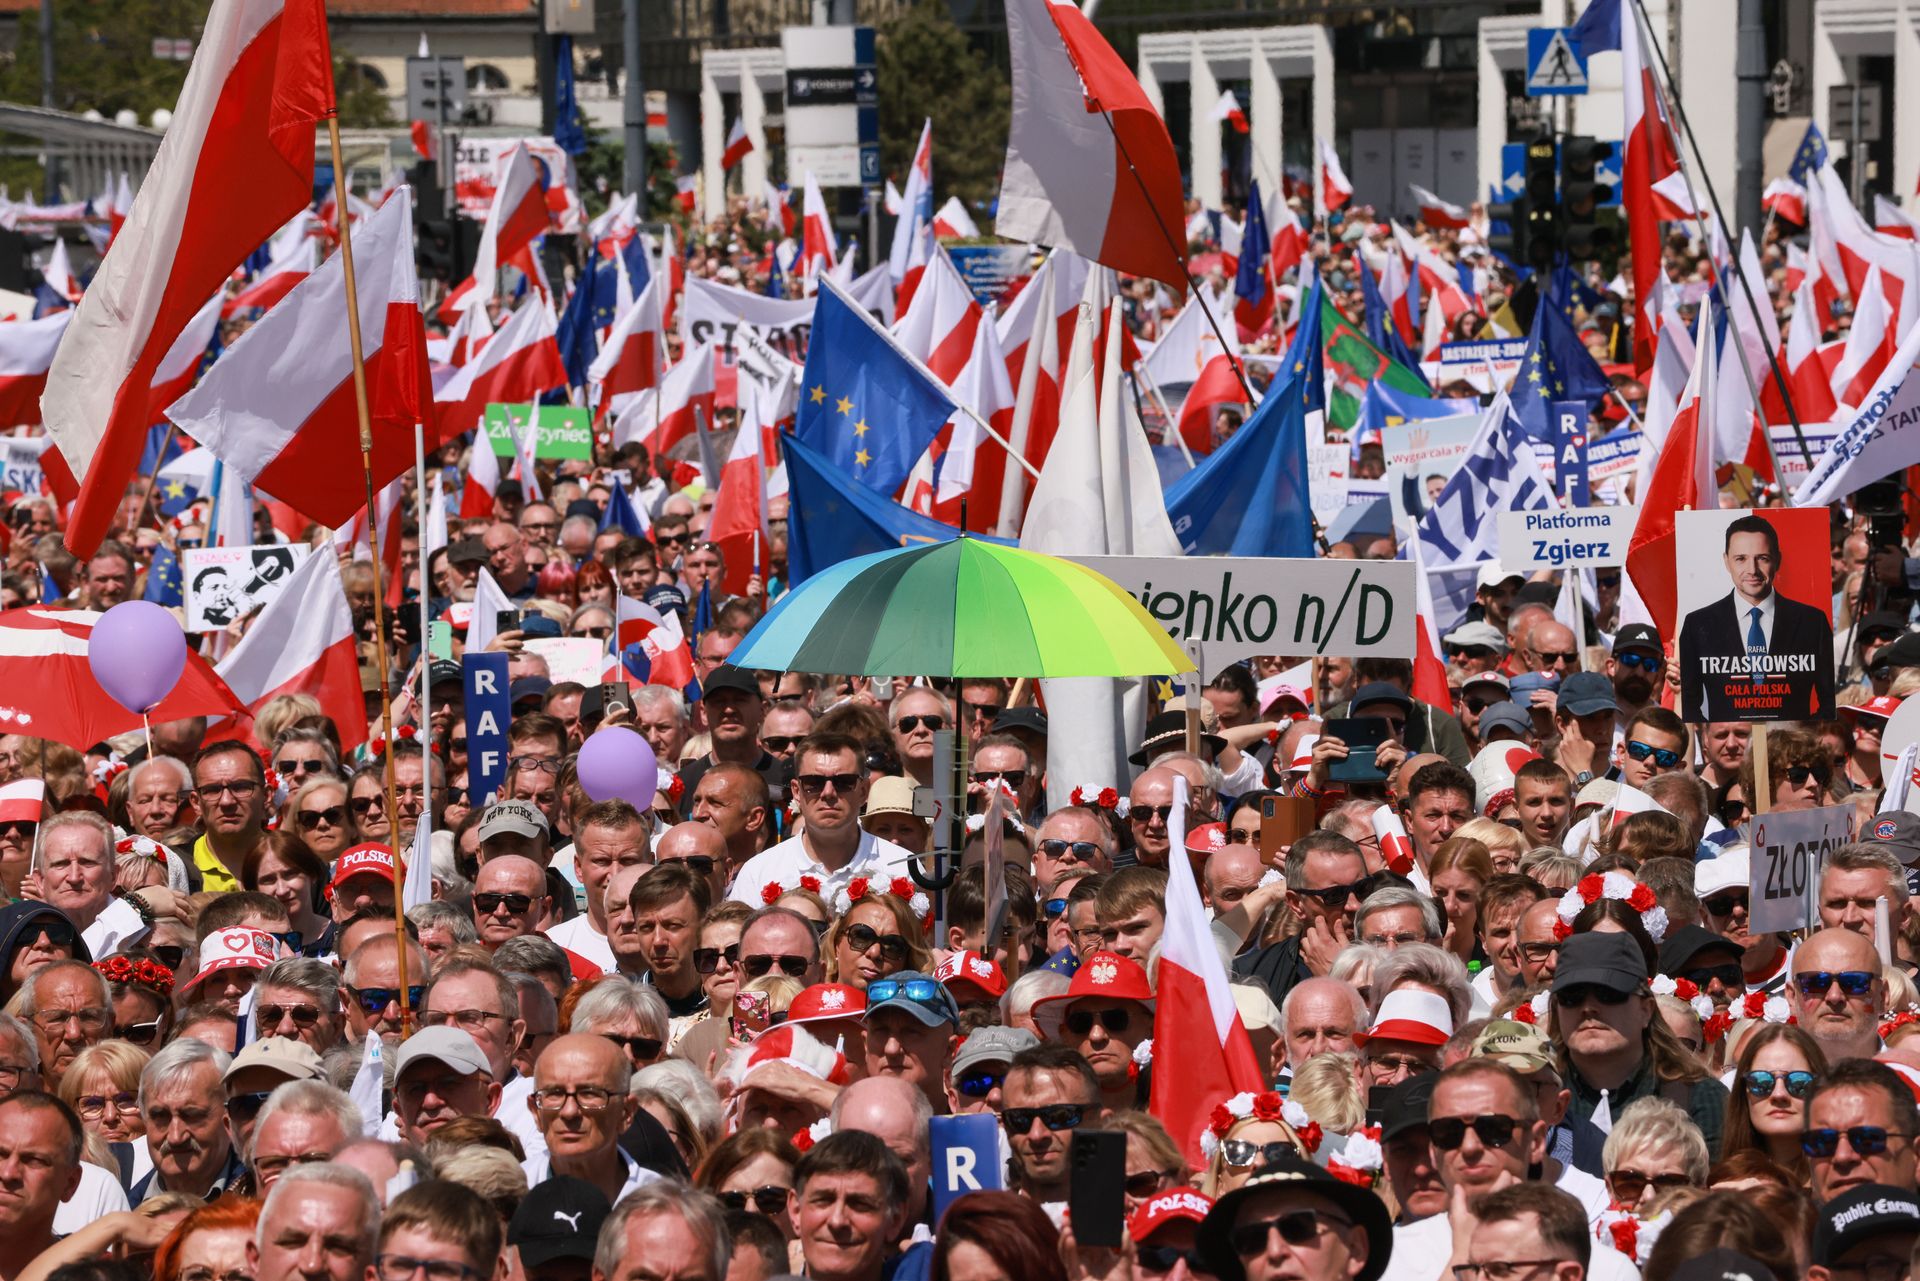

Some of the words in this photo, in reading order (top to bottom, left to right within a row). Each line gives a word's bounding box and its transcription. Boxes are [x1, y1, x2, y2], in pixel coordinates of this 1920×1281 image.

[1525, 512, 1611, 530] Platforma
[1532, 538, 1611, 566] Zgierz
[1128, 571, 1278, 644] ienko
[1293, 568, 1394, 655] n/D
[1747, 645, 1767, 654] RAFAŁ
[1700, 654, 1816, 674] TRZASKOWSKI
[1724, 684, 1751, 697] CAŁA
[1753, 683, 1791, 696] POLSKA
[1733, 694, 1783, 709] NAPRZÓD!
[475, 669, 500, 807] RAFA
[486, 806, 506, 824] NEW
[508, 805, 533, 823] YORK
[343, 849, 394, 869] POLSKA
[1147, 1192, 1211, 1219] POLSK
[1831, 1201, 1875, 1234] Public
[1874, 1198, 1920, 1219] Enemy
